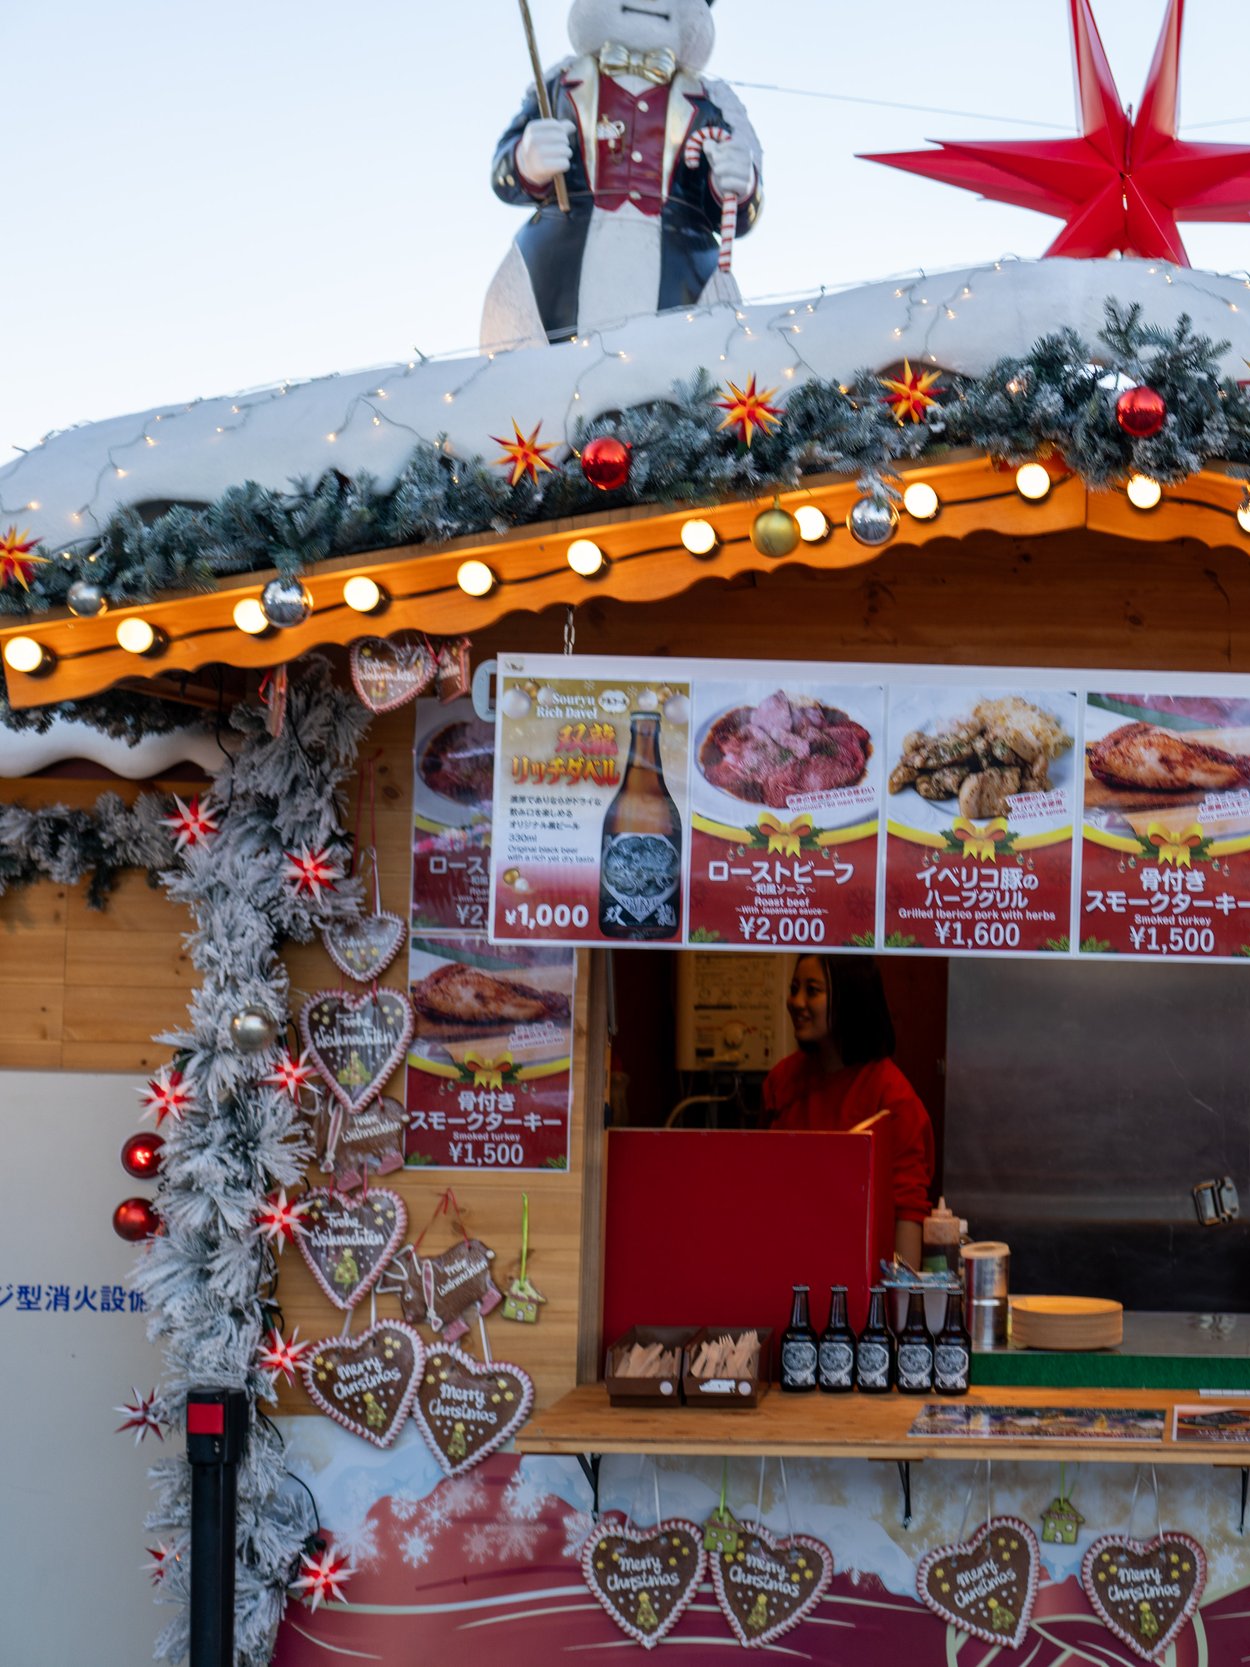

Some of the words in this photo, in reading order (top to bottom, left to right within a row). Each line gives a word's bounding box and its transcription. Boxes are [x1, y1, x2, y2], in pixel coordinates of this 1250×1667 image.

[536, 706, 564, 719] Rich
[565, 706, 599, 719] Davel
[512, 755, 621, 786] リッチダベル
[508, 833, 538, 842] 330ml
[708, 860, 855, 885] ローストビーフ
[916, 865, 1039, 890] イベリコ豚の
[1140, 867, 1206, 892] 骨付き
[754, 896, 785, 907] Roast
[786, 896, 811, 907] beef
[924, 889, 1029, 909] ハーブグリル
[505, 902, 590, 930] ¥1,000
[898, 908, 934, 919] Grilled
[975, 910, 1000, 921] pork
[1001, 909, 1024, 920] with
[1026, 909, 1057, 921] herbs
[1134, 914, 1176, 925] Smoked
[1178, 914, 1212, 927] turkey
[738, 915, 826, 944] ¥2,000
[934, 920, 1021, 949] ¥1,600
[1129, 925, 1215, 954] ¥1,500
[335, 1011, 371, 1027] Frohe
[458, 1091, 516, 1112] 骨付き
[410, 1111, 562, 1132] スモークターキー
[453, 1130, 489, 1141] Smoked
[491, 1131, 521, 1142] turkey
[449, 1141, 524, 1166] ¥1,500
[323, 1212, 362, 1229] Frohe
[311, 1228, 384, 1247] Weihnachten
[336, 1356, 385, 1381] Merry
[333, 1366, 402, 1400] Christmas
[440, 1382, 486, 1406] Merry
[429, 1398, 498, 1424] Christmas
[618, 1555, 663, 1576] Merry
[745, 1551, 790, 1579] Merry
[956, 1558, 999, 1587] Merry
[1117, 1566, 1164, 1585] Merry
[606, 1570, 680, 1593] Christmas
[729, 1565, 801, 1597] Christmas
[953, 1567, 1017, 1609] Christmas
[1108, 1582, 1181, 1602] Christmas
